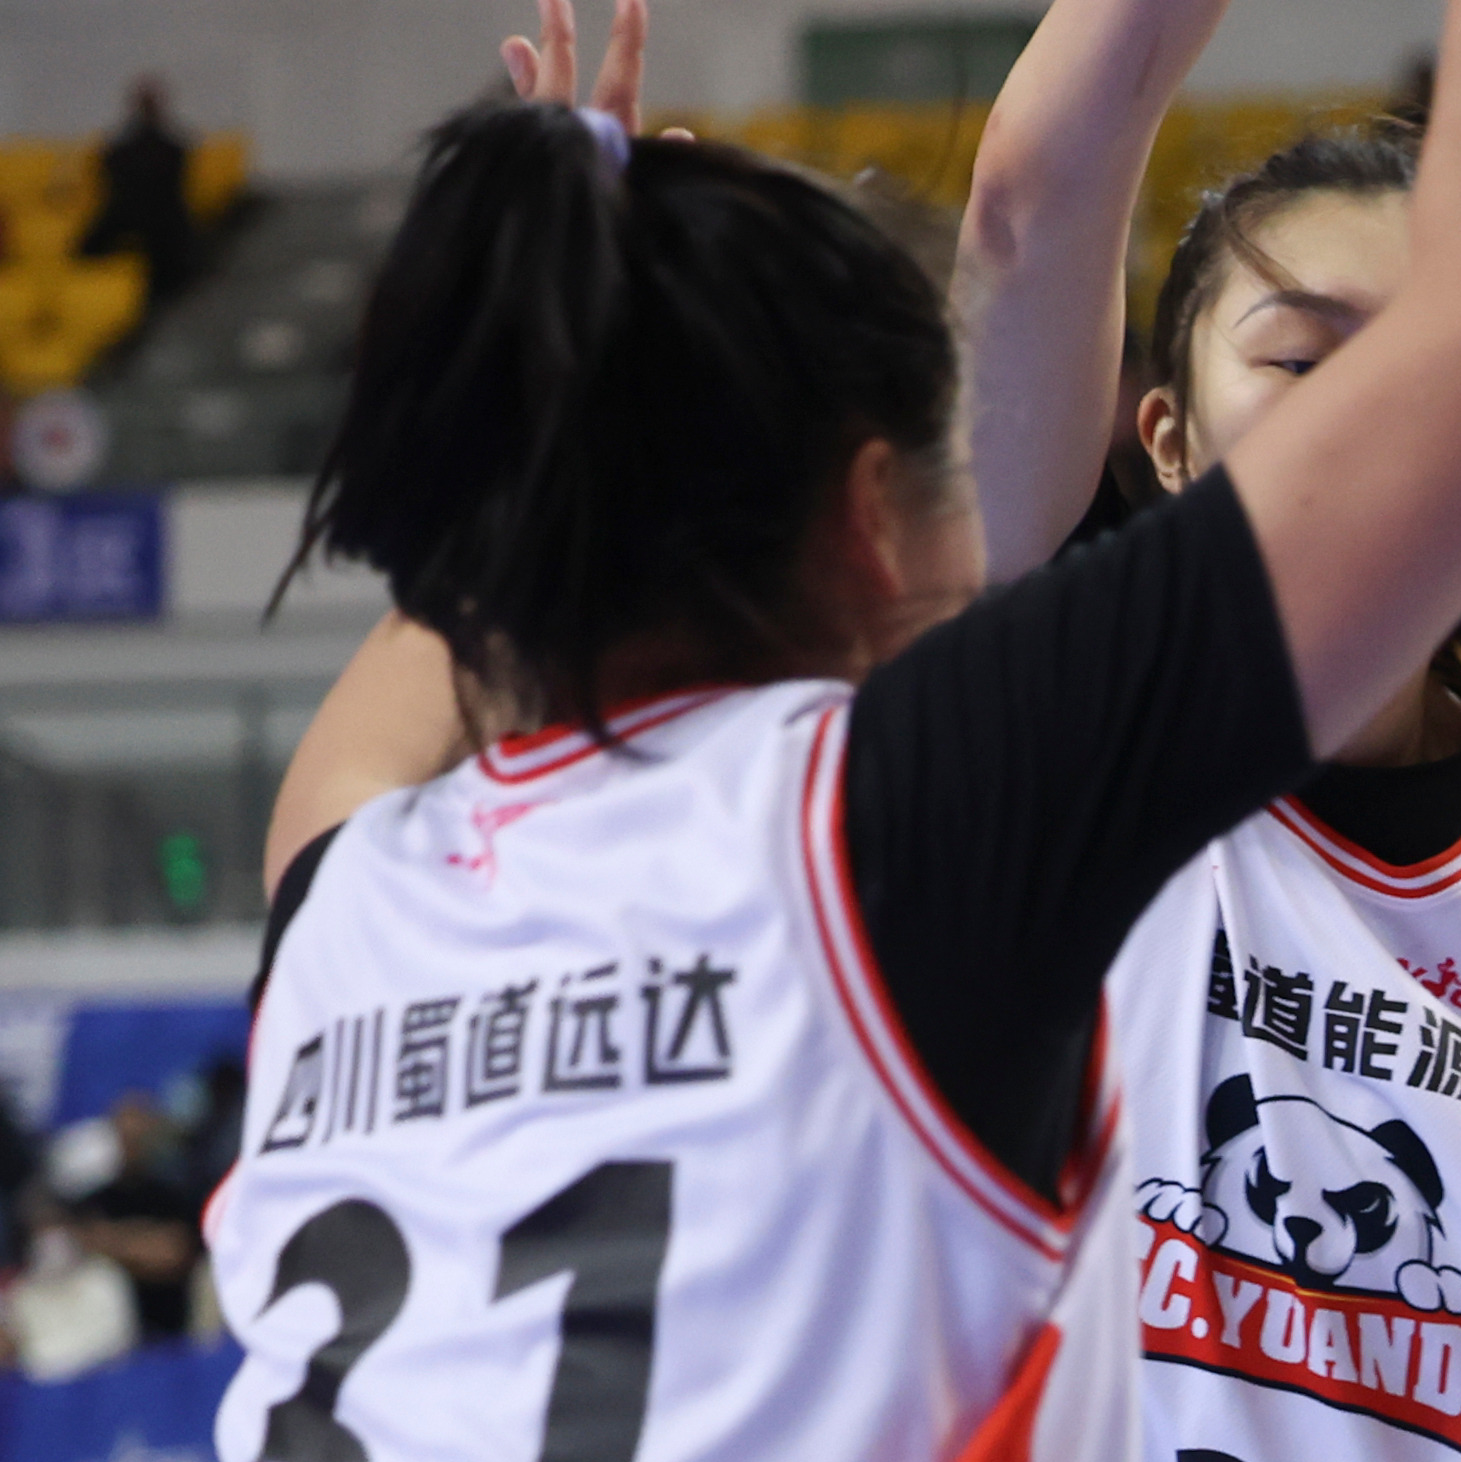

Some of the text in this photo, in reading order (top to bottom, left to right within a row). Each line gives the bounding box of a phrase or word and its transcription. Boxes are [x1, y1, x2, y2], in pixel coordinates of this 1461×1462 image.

[257, 952, 738, 1158] 四川蜀道远达
